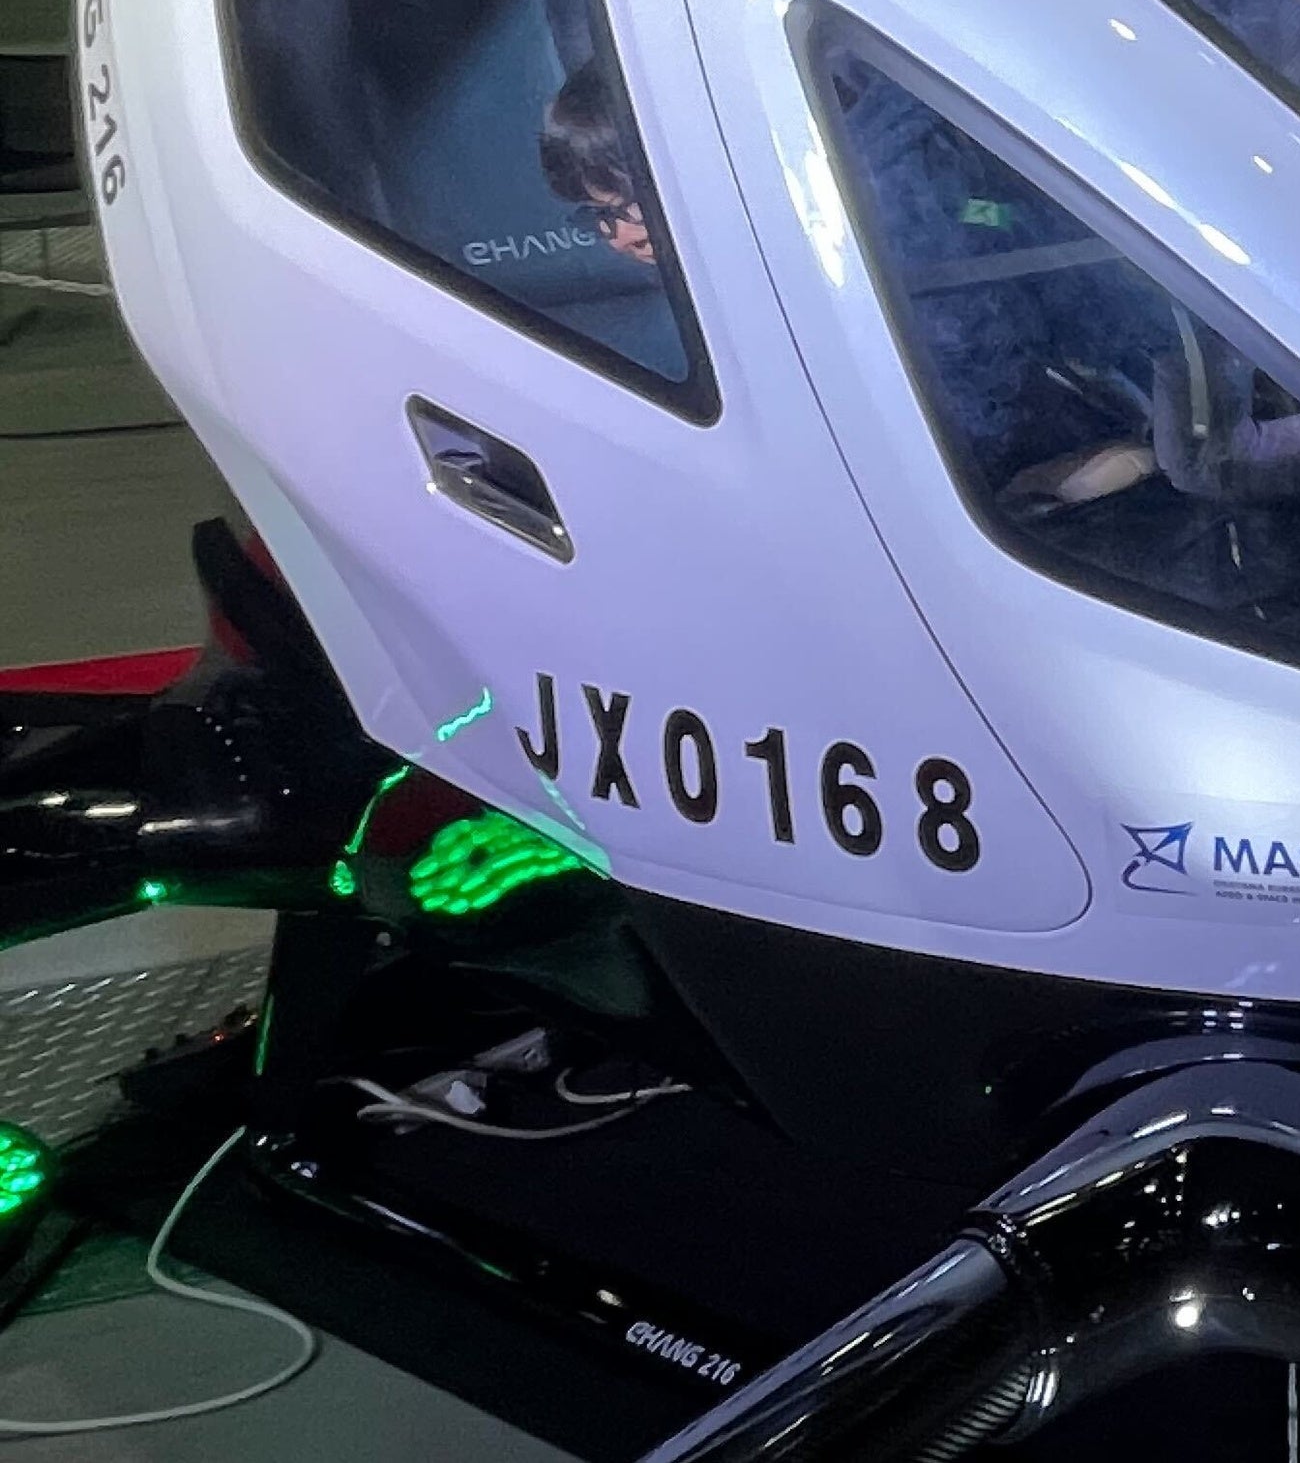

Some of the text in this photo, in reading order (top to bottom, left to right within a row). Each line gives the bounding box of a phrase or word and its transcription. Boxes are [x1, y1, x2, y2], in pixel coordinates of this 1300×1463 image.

[87, 63, 127, 206] 216
[514, 671, 980, 873] JX0168
[697, 1352, 741, 1386] 216
